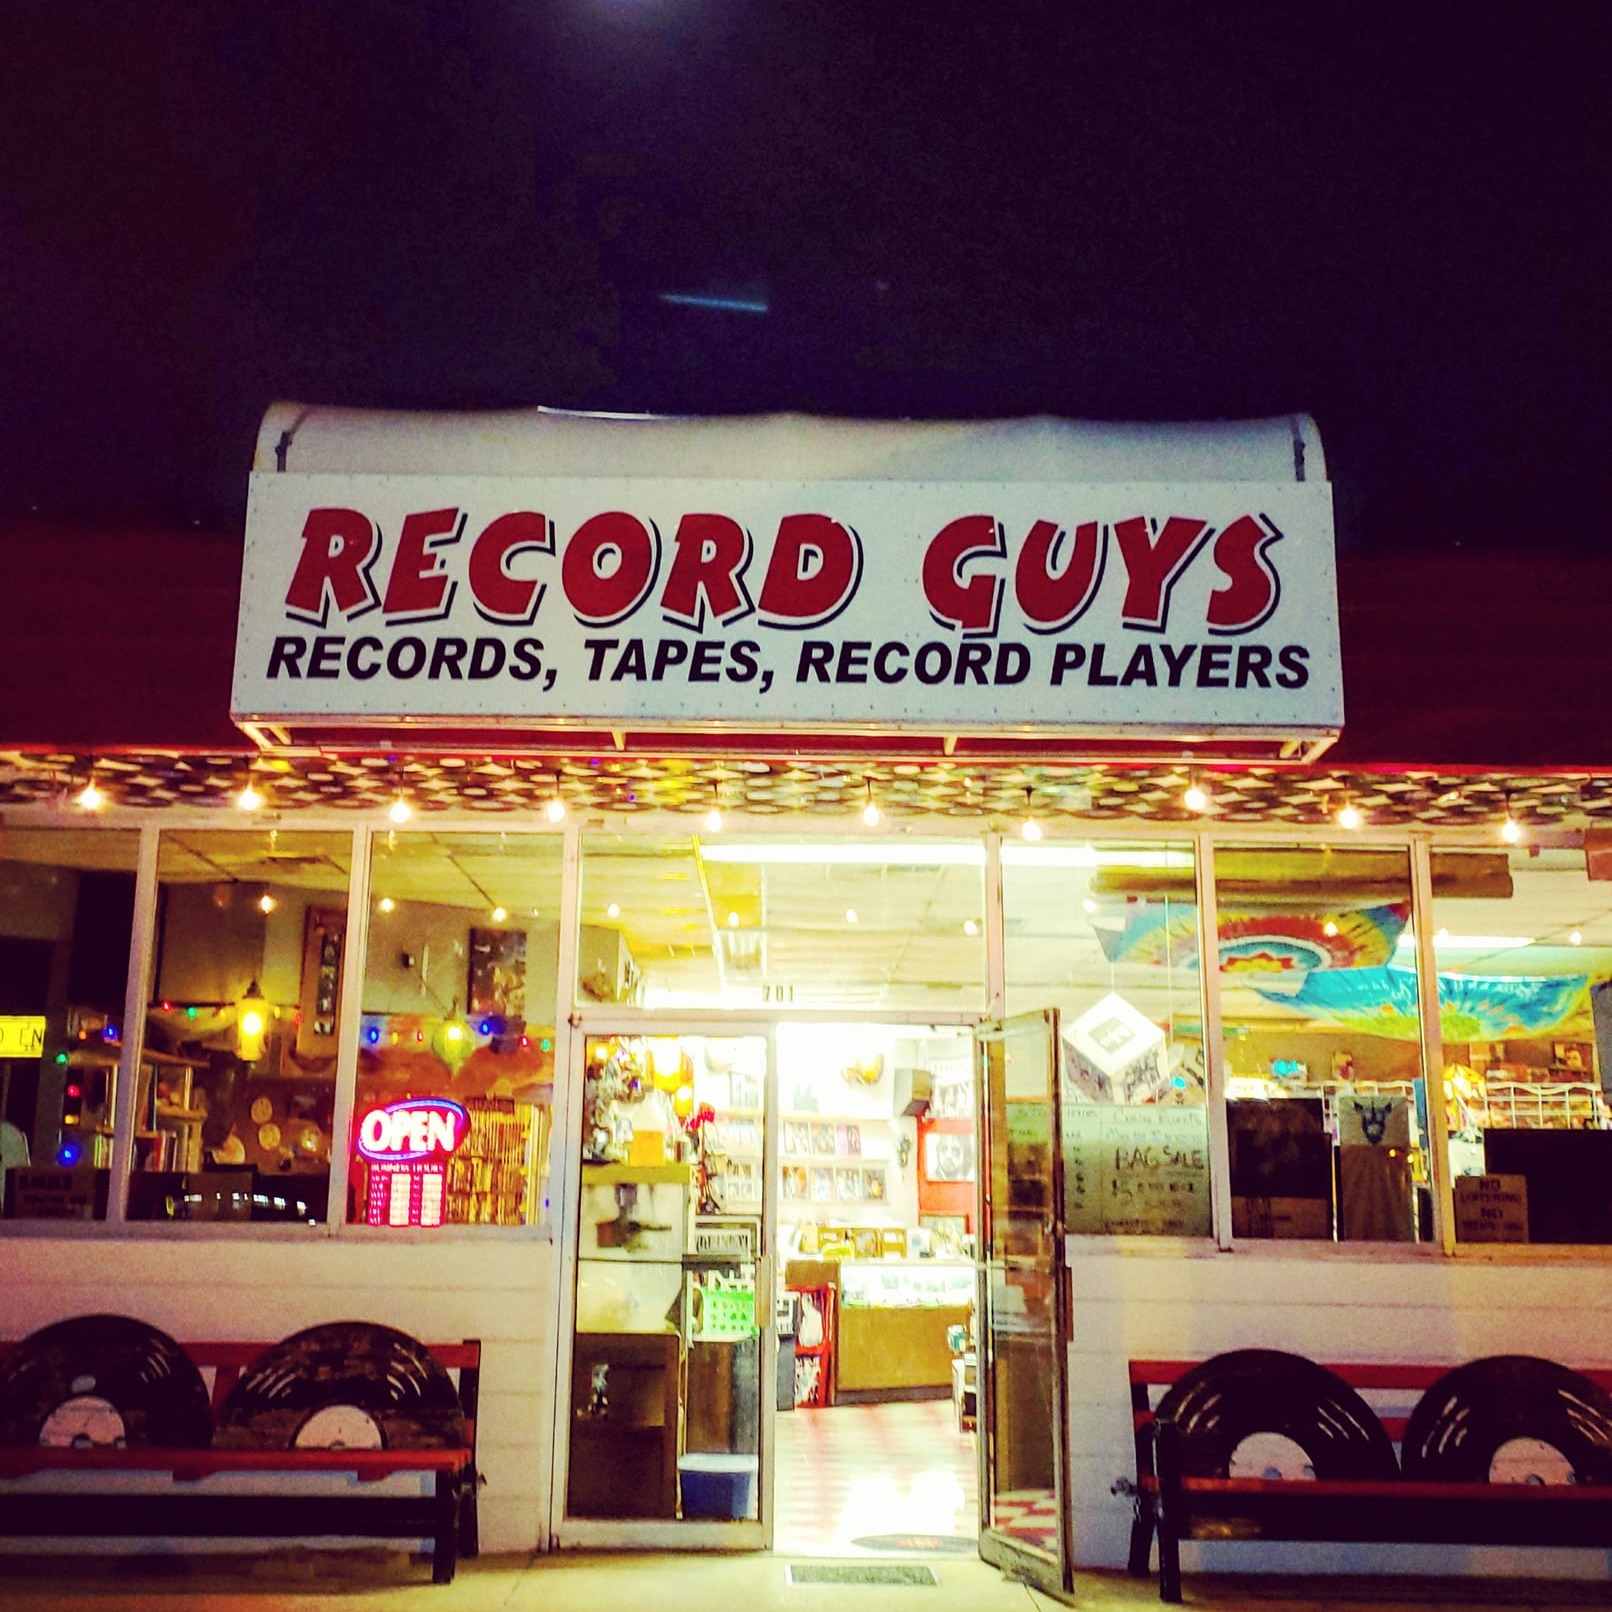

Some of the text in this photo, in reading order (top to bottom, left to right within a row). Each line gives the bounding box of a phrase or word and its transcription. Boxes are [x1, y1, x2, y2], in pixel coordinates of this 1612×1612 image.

[285, 507, 1284, 639] RECORD GUYS
[266, 636, 1311, 694] RECORDS, TAPES, RECORD PLAYERS
[762, 985, 793, 1003] 701
[361, 1109, 456, 1152] OPEN
